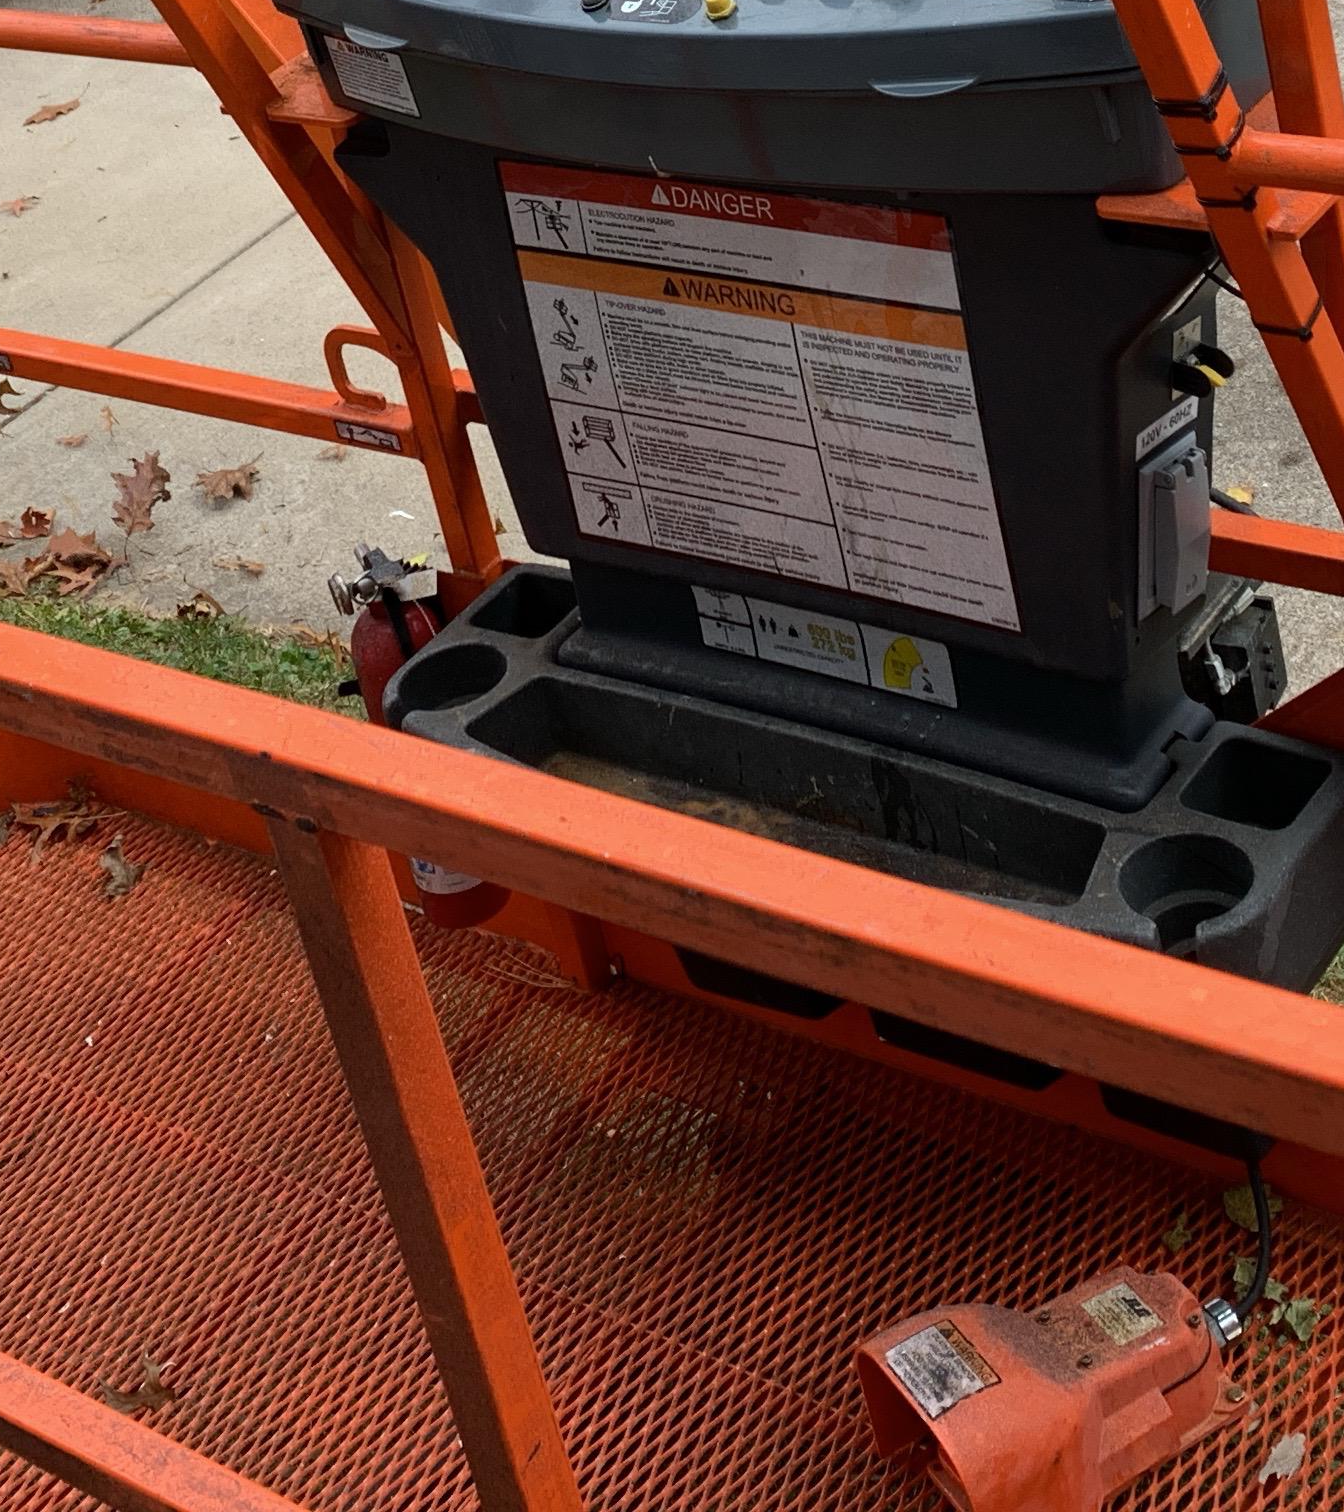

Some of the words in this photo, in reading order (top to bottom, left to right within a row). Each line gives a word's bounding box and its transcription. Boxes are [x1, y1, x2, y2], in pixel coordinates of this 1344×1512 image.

[587, 208, 646, 223] ELECTROCUTION
[646, 215, 676, 228] HAZARD
[671, 186, 775, 221] DANGER
[679, 277, 797, 317] WARNING
[811, 342, 854, 357] INSPECTED
[871, 352, 917, 367] OPERATING
[917, 359, 961, 374] PROPERLY
[818, 333, 854, 347] MACHINE
[854, 339, 876, 350] MUST
[907, 347, 930, 360] USED
[930, 351, 954, 364] UNTIL
[1142, 423, 1162, 449] 120V
[1168, 402, 1193, 429] 60HZ
